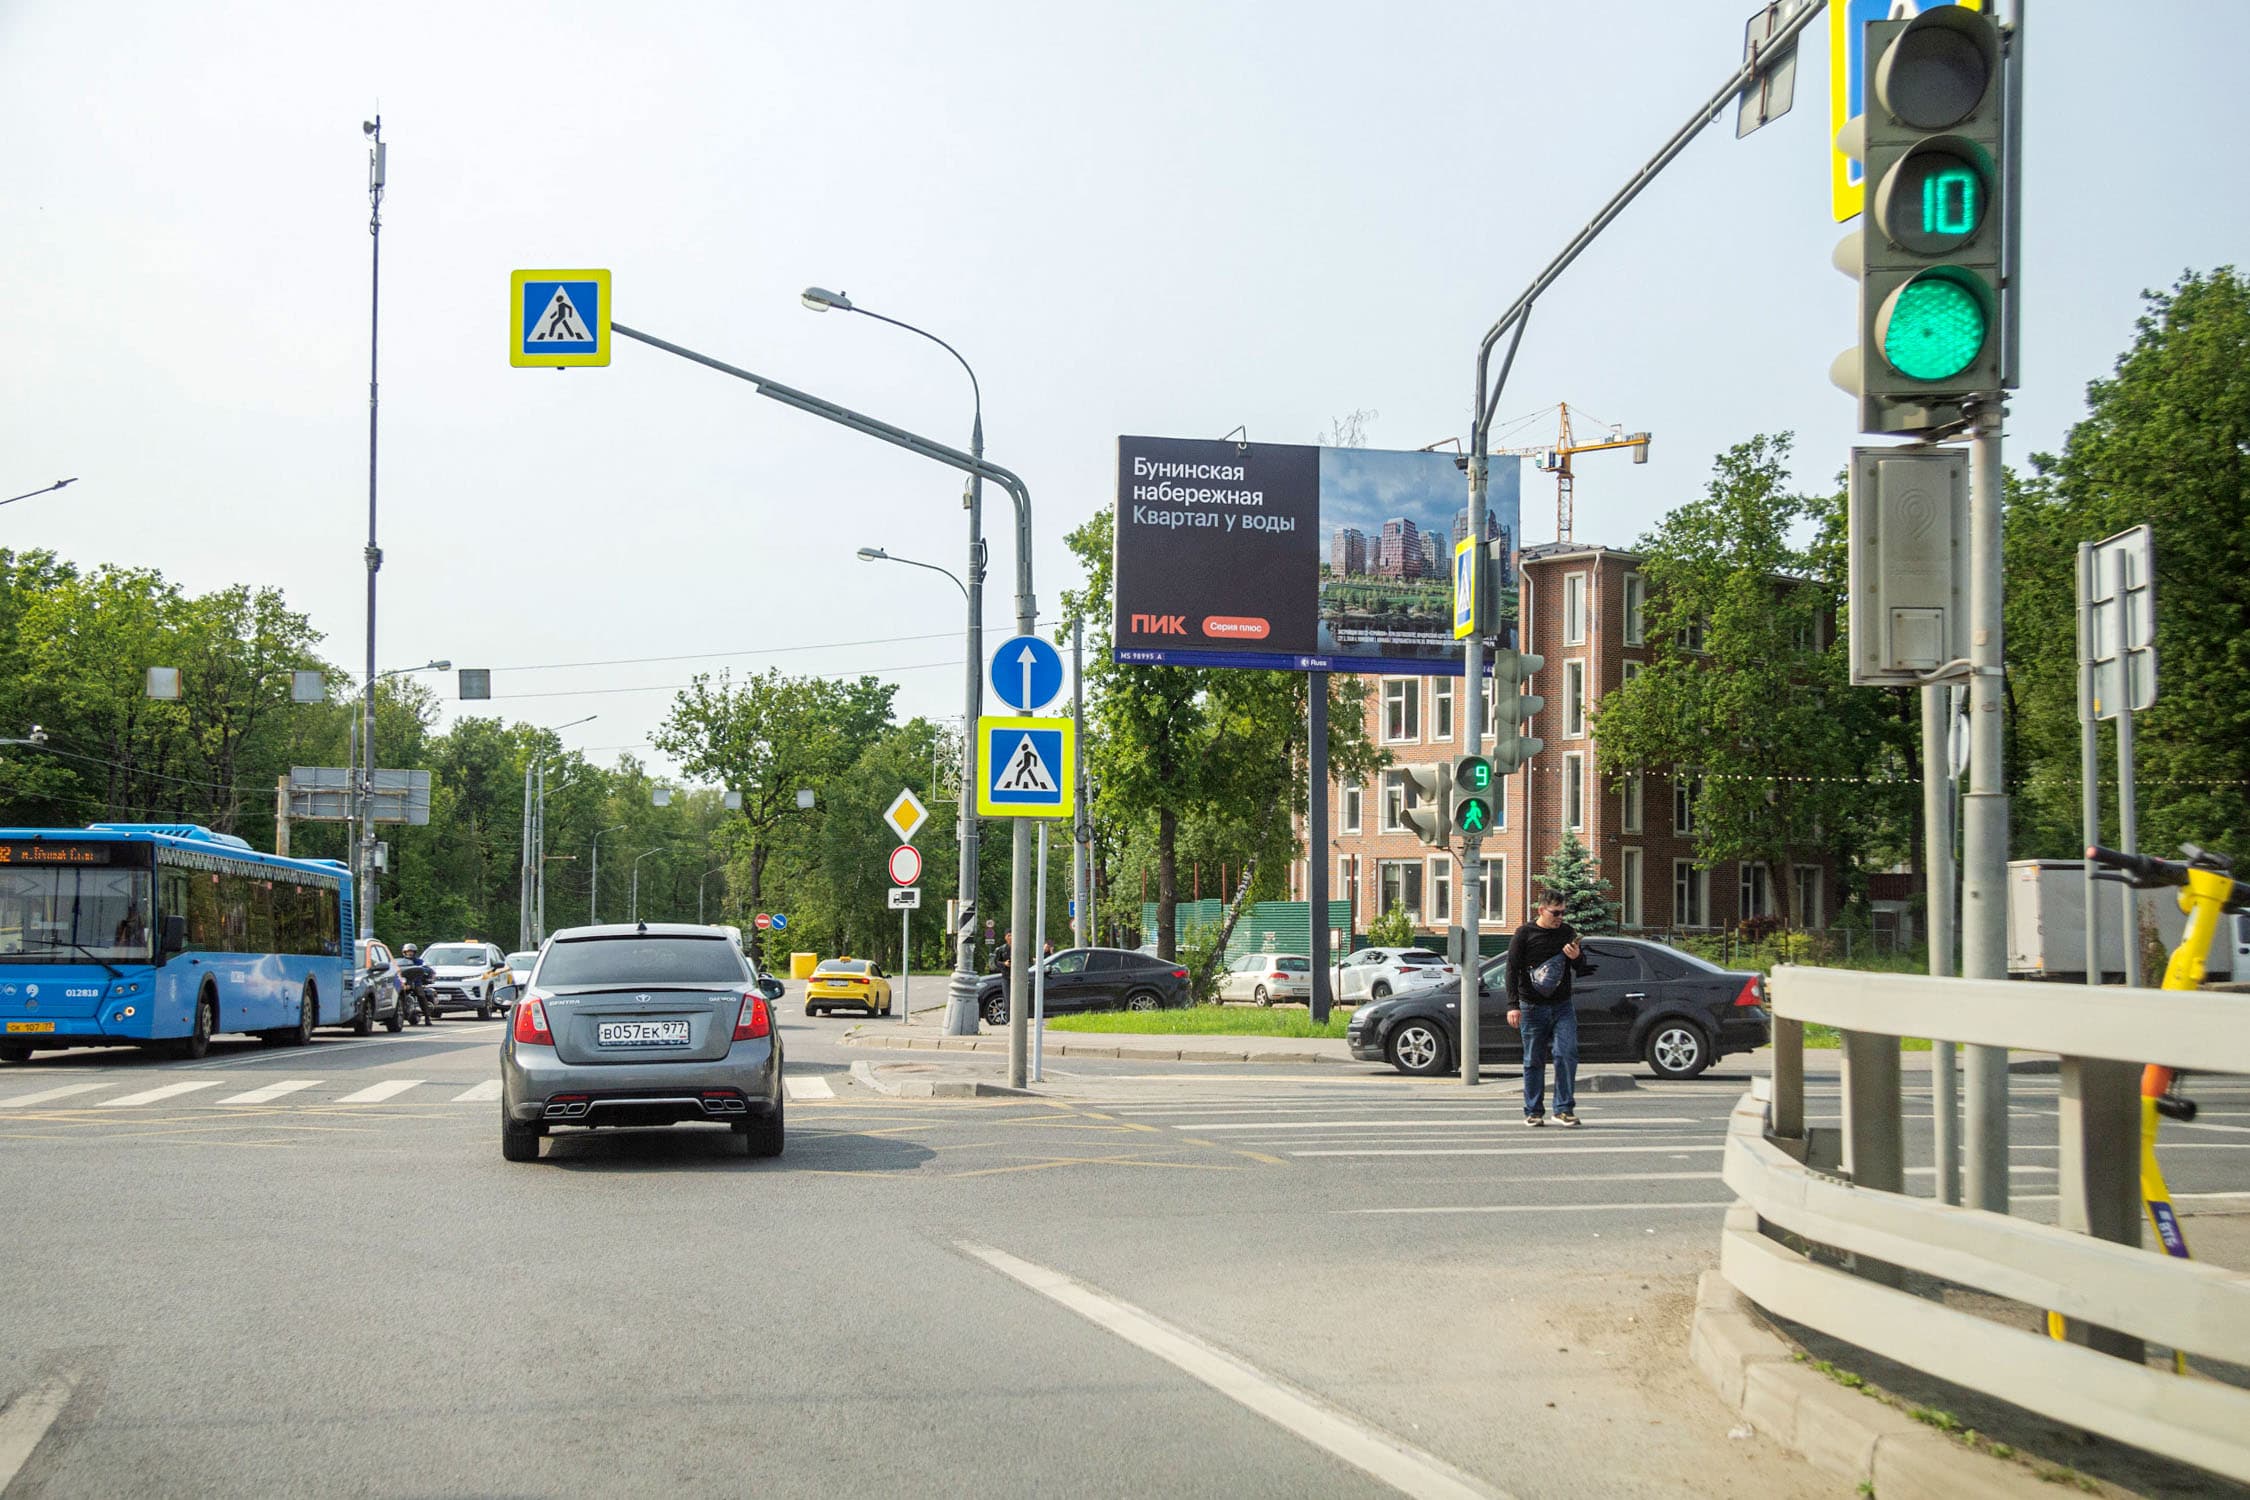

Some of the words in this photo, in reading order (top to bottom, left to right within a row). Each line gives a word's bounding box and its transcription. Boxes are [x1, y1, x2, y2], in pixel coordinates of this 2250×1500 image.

[1923, 170, 1974, 234] 10
[1133, 457, 1245, 481] Бунинская
[1133, 481, 1263, 506] набережная
[1133, 505, 1219, 529] Квартал
[1224, 513, 1237, 532] у
[1242, 515, 1296, 533] воды
[1131, 613, 1188, 635] ПИК
[1210, 621, 1238, 633] Серия
[1239, 624, 1263, 633] плюс
[1475, 766, 1487, 786] 9
[65, 988, 99, 998] 012818
[603, 1024, 660, 1040] В057ЕК
[662, 1023, 685, 1035] 977
